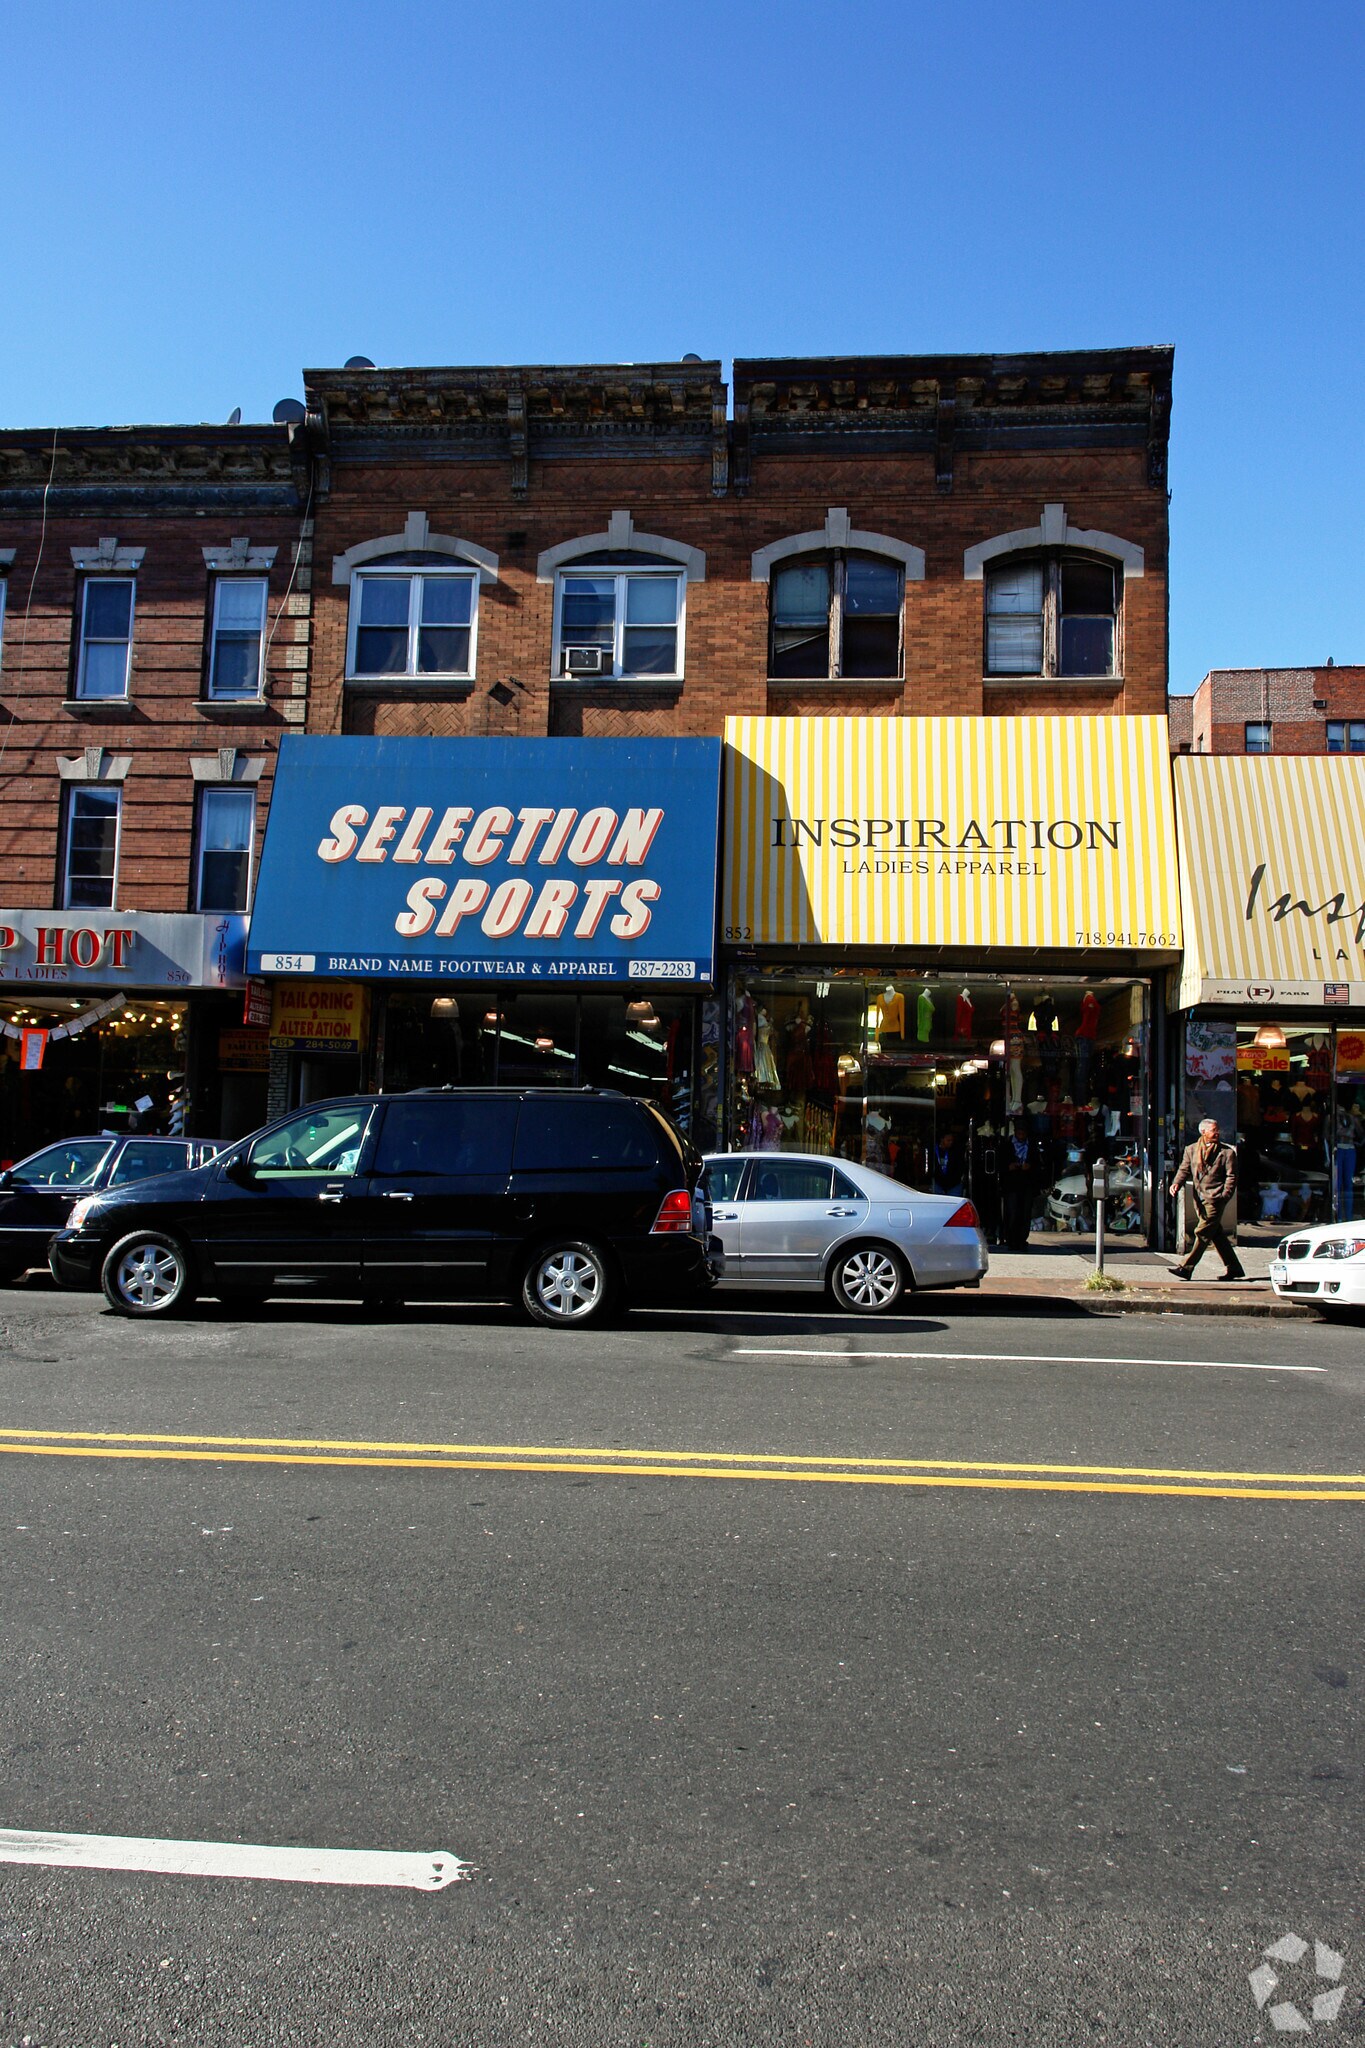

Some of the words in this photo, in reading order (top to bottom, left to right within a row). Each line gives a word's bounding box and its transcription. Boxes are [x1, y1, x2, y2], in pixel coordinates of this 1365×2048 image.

[317, 804, 665, 867] SELECTION
[771, 818, 1122, 850] INSPIRATION
[842, 860, 930, 874] LADIES
[938, 861, 1047, 876] APPAREL
[394, 877, 662, 940] SPORTS
[725, 926, 751, 940] 852
[1075, 932, 1177, 946] 718.941.7662
[33, 927, 133, 968] HOT
[1312, 948, 1365, 960] LA
[275, 956, 303, 970] 854
[328, 957, 382, 971] BRAND
[388, 959, 433, 973] NAME
[439, 960, 526, 974] FOOTWEAR
[531, 962, 542, 975] &
[547, 961, 618, 975] APPAREL
[632, 962, 692, 977] 287-2283
[15, 967, 67, 979] LADIES
[167, 970, 189, 982] 856
[279, 991, 354, 1010] TAILORING
[278, 1020, 351, 1038] ALTERATION
[276, 1037, 290, 1047] 854
[304, 1039, 352, 1049] 284-5069
[1252, 1056, 1289, 1070] sale
